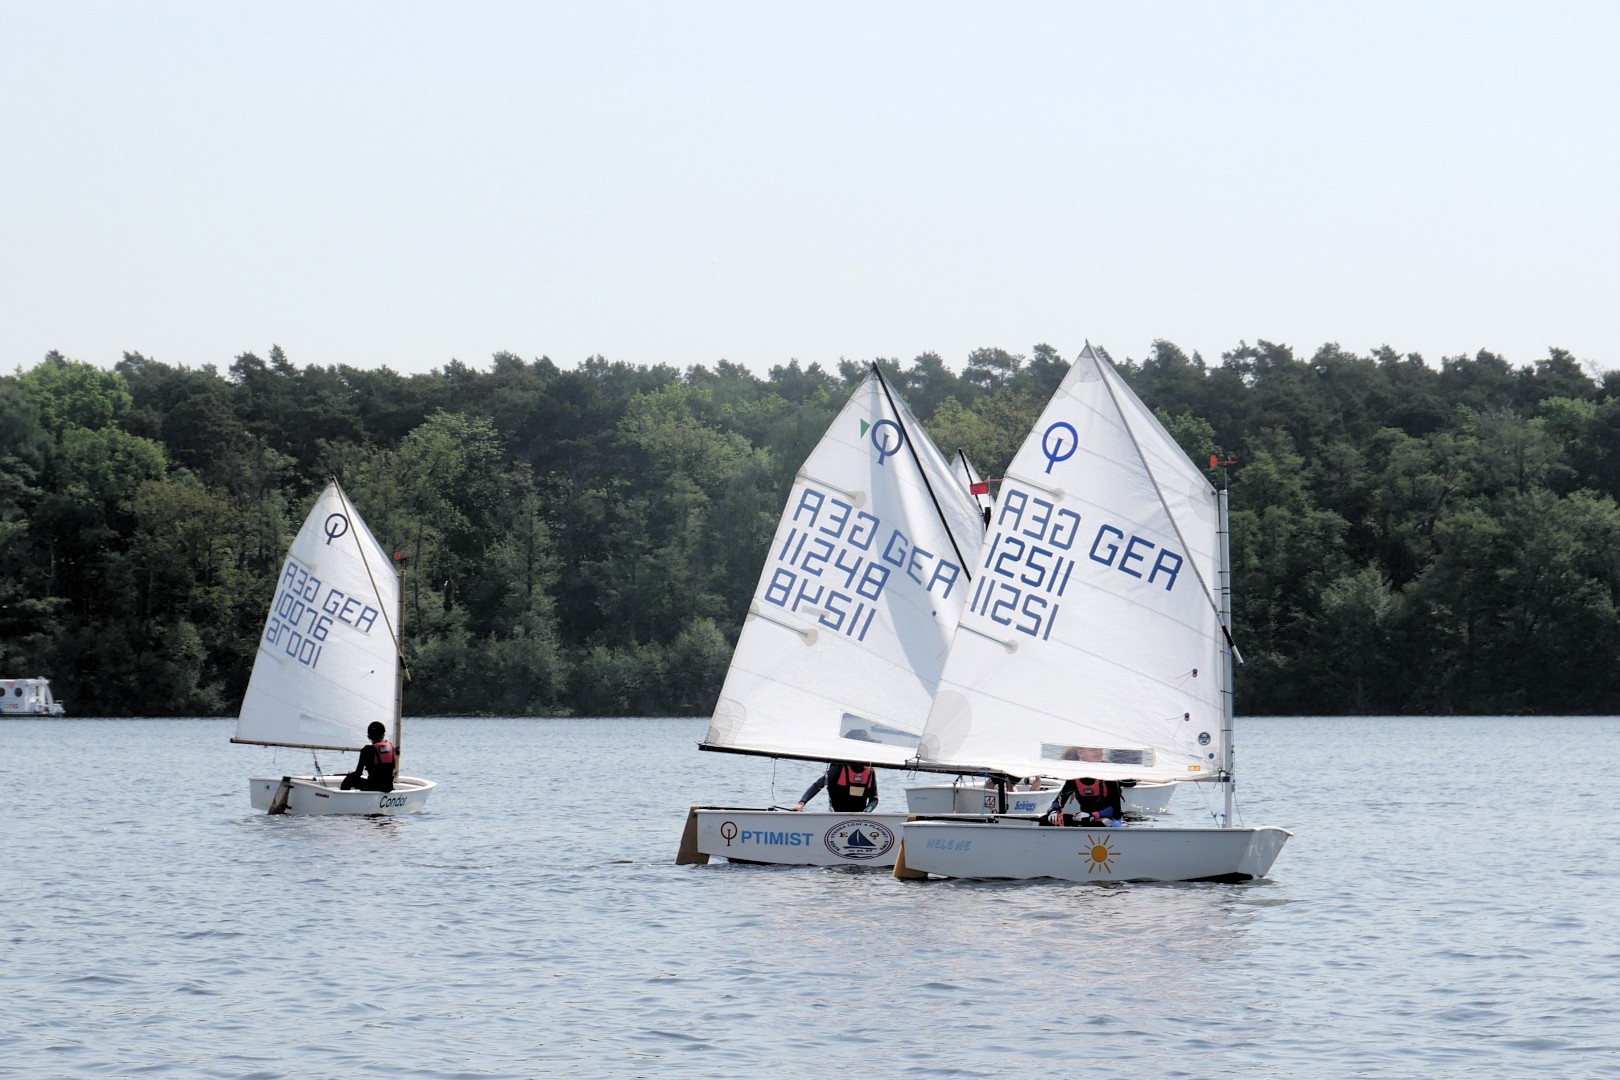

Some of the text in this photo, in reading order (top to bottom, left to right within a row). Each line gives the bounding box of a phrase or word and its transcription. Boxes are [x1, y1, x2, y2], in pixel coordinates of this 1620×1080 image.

[779, 528, 891, 602] 11248
[882, 529, 961, 599] GER
[984, 532, 1075, 597] 12511
[1089, 524, 1183, 591] GER
[274, 589, 335, 642] 10076
[322, 588, 379, 633] GER
[379, 794, 407, 808] Condor
